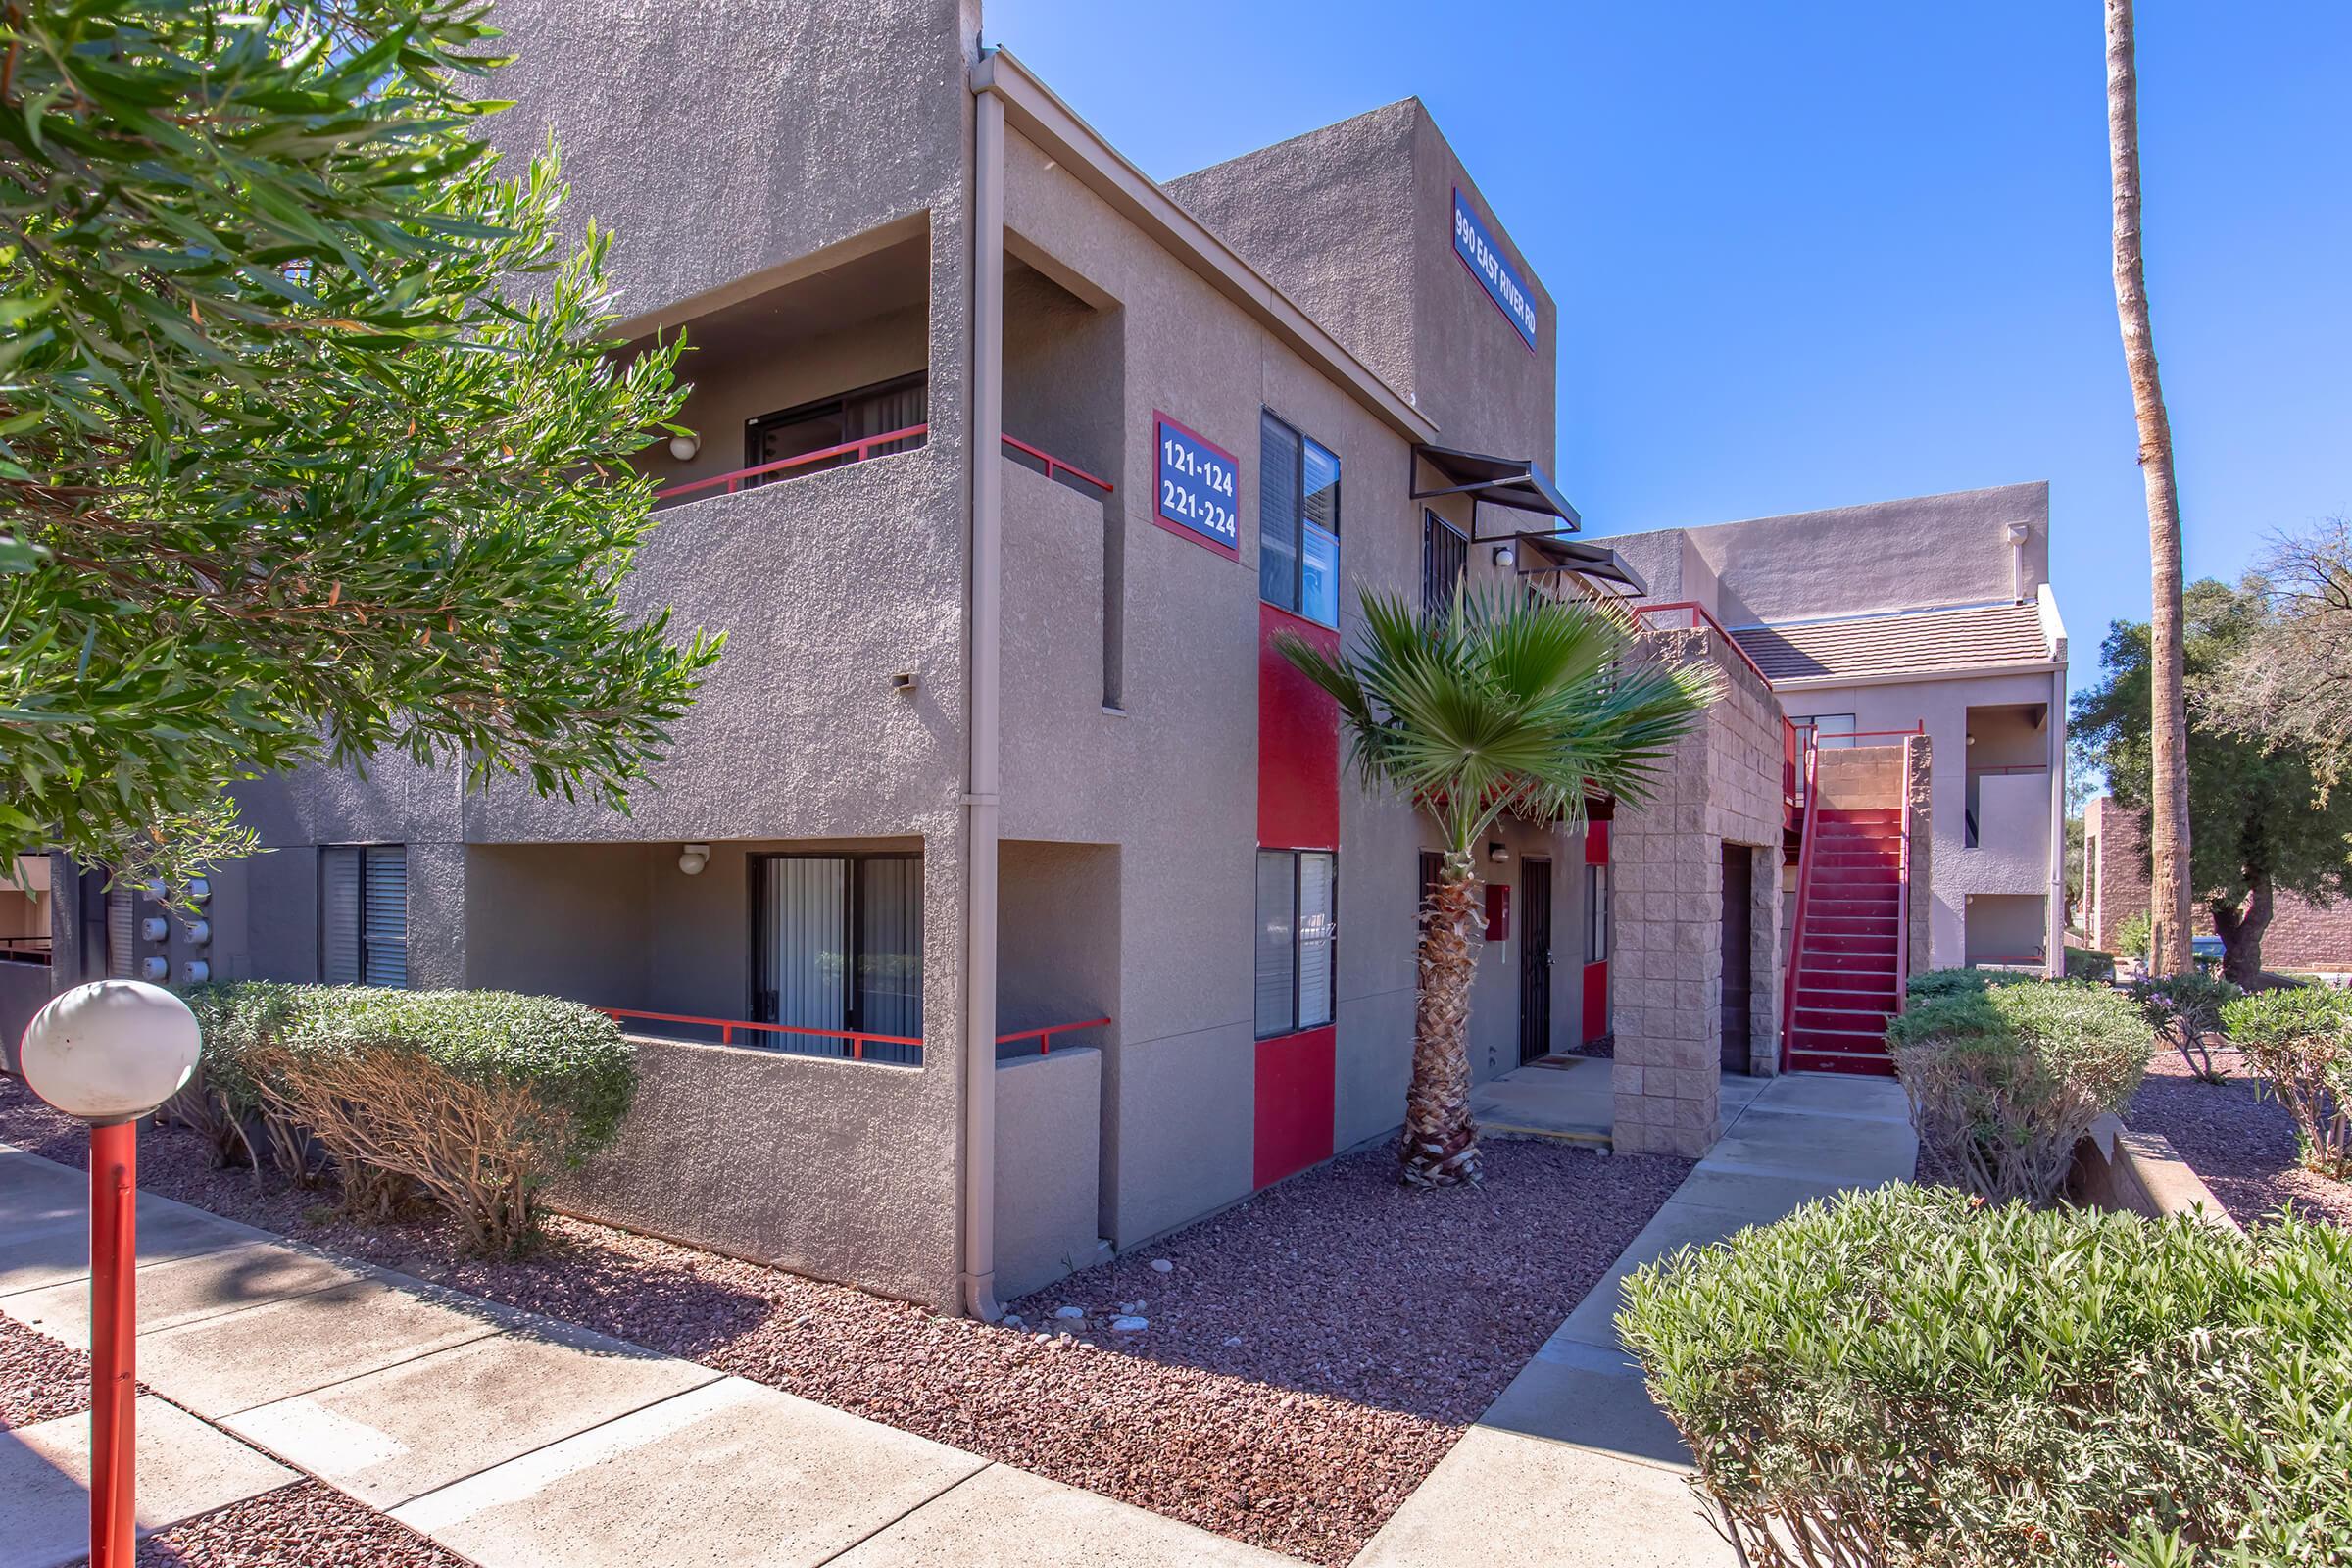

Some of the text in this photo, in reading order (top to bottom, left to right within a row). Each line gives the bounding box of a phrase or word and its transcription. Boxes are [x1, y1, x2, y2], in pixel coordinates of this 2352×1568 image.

[1456, 209, 1536, 334] 990 EAST RIVER RD
[1165, 439, 1233, 497] 121-124
[1163, 480, 1235, 538] 221-224
